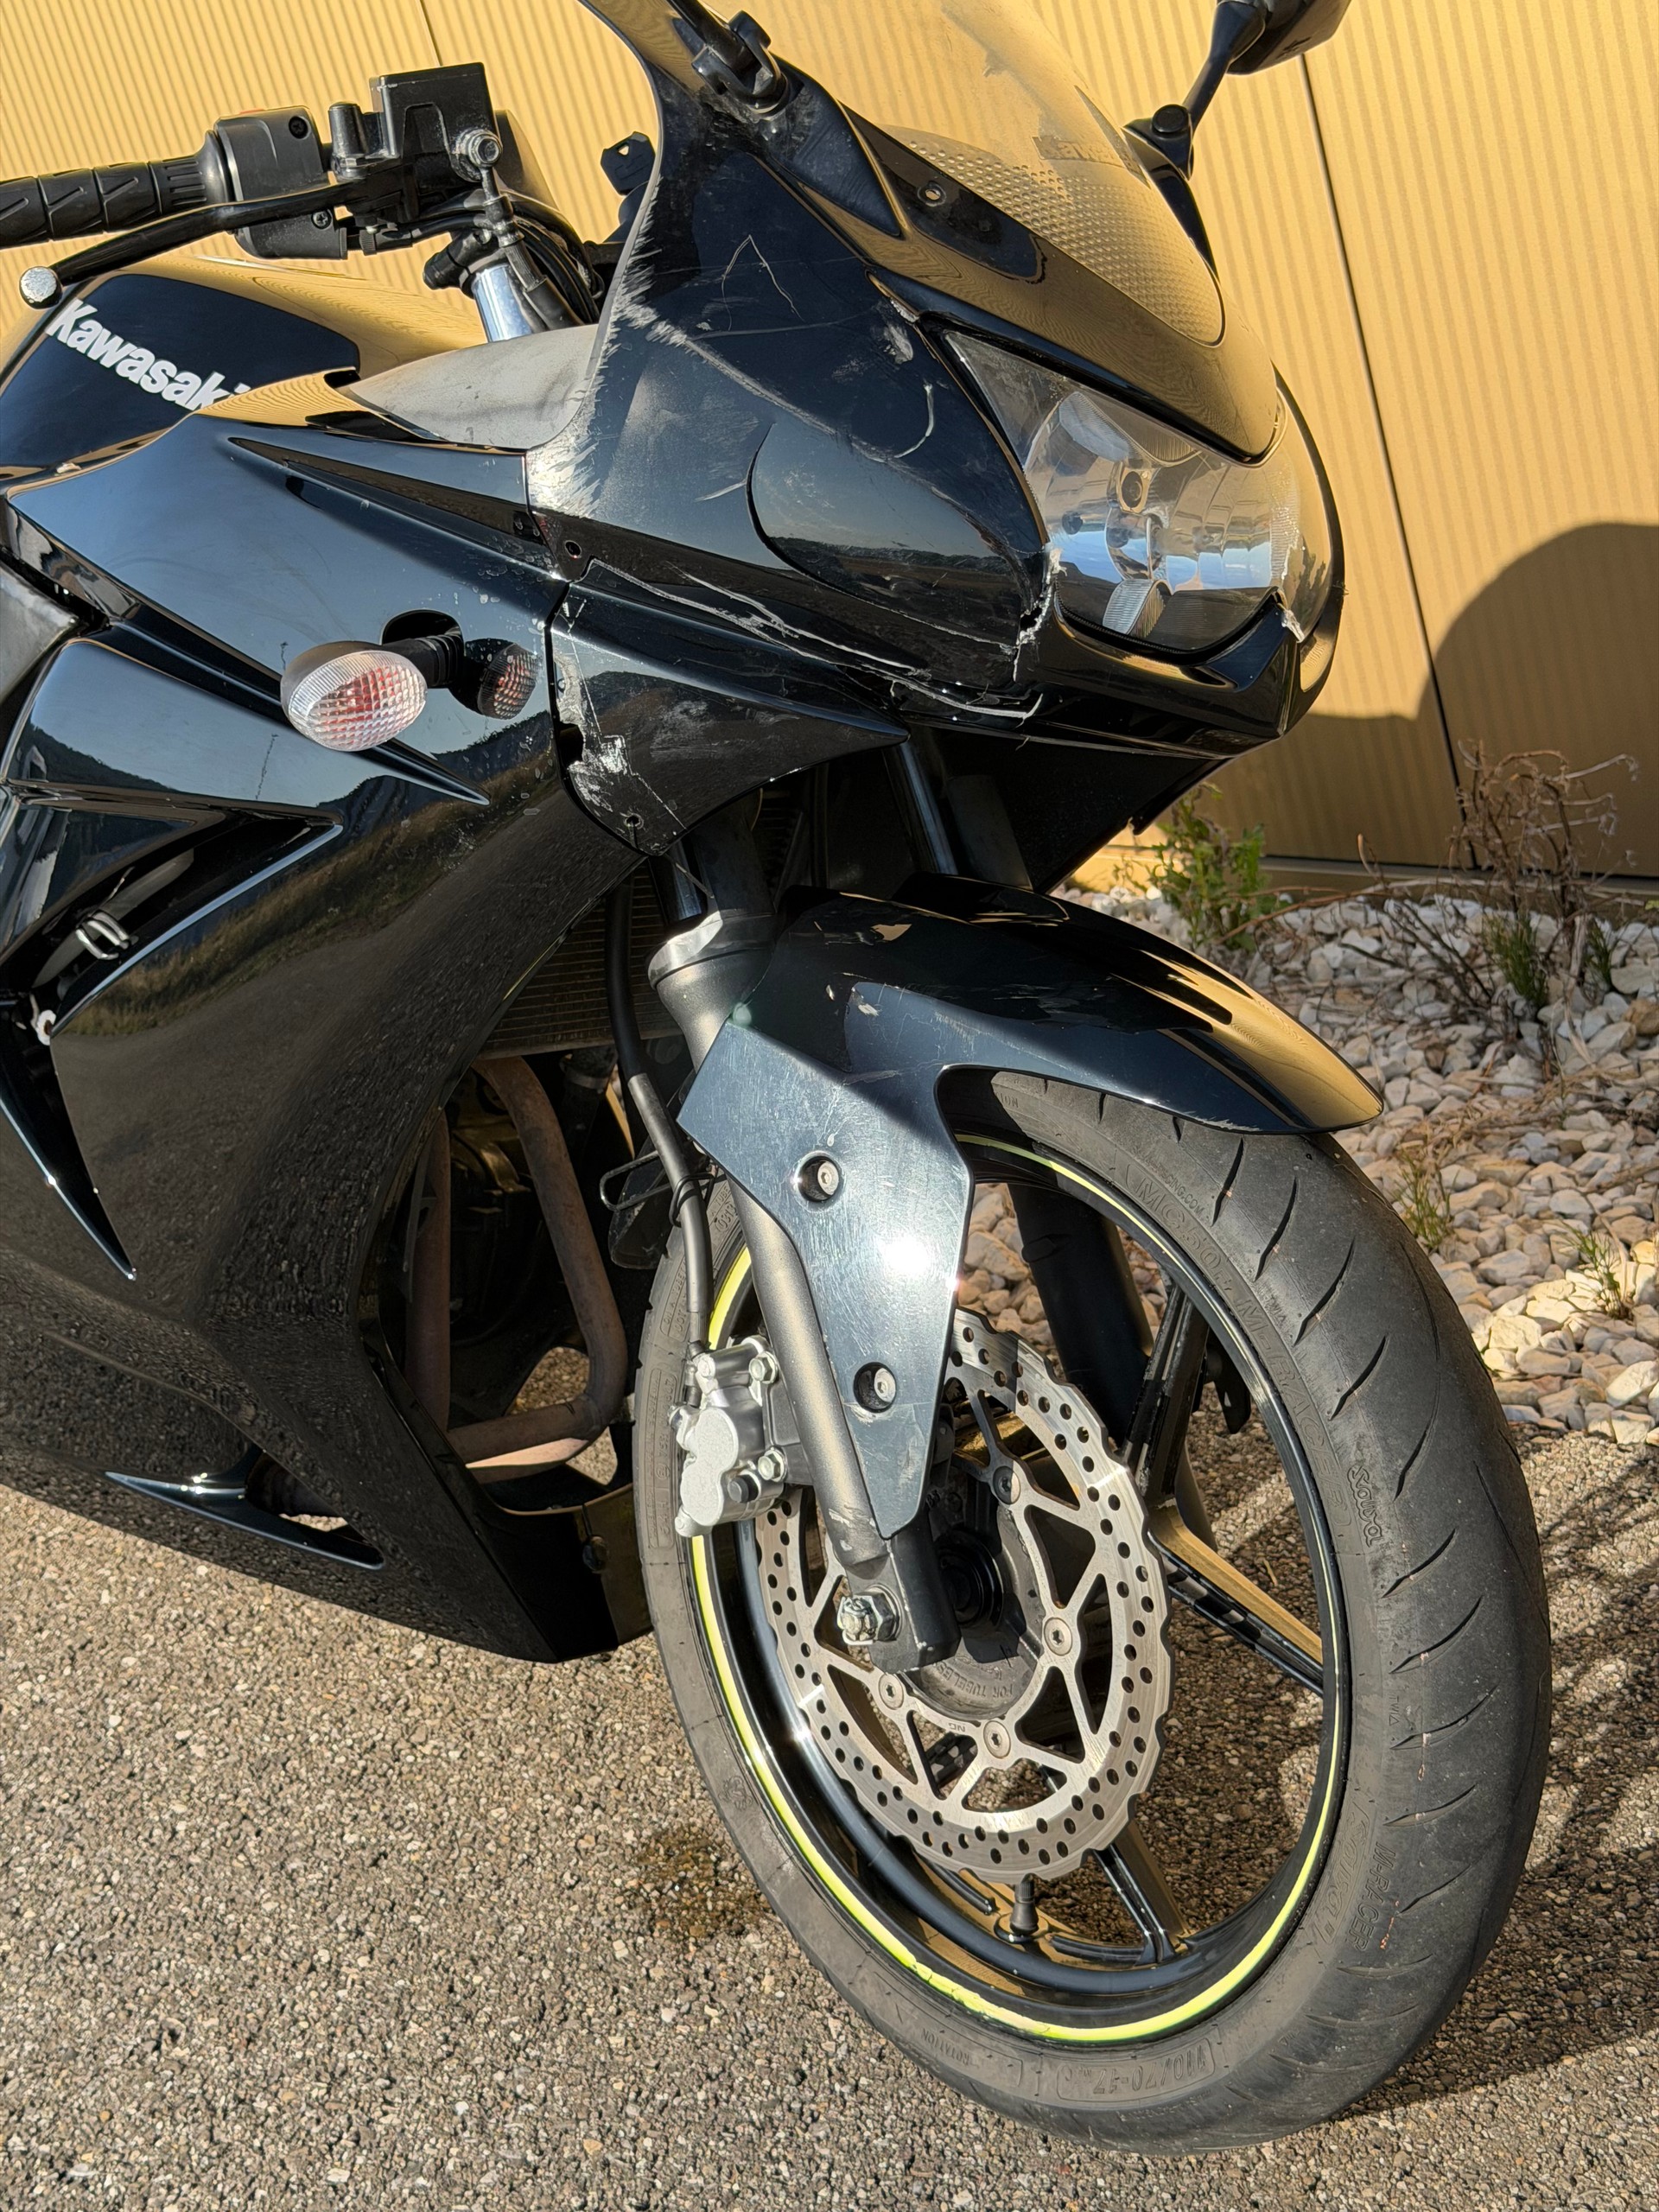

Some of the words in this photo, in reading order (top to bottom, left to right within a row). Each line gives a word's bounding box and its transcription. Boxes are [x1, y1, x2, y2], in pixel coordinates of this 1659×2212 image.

[1345, 1840, 1396, 1952] M-RACER
[921, 2027, 969, 2066] ROTATION
[1092, 2044, 1206, 2094] 110/70-17
